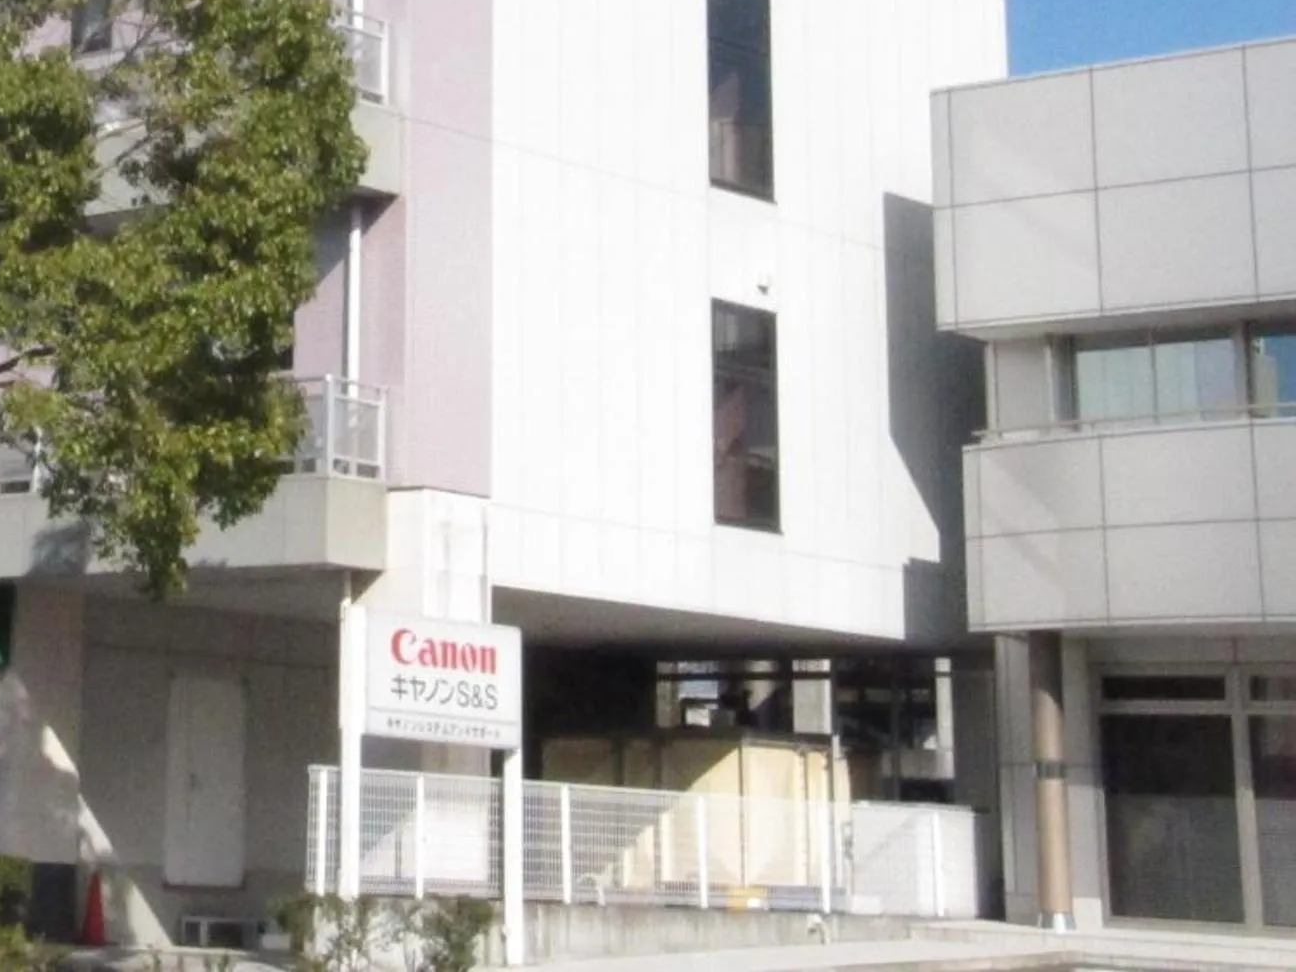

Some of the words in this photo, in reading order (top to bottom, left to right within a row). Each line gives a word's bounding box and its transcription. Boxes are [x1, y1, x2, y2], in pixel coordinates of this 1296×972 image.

[391, 628, 497, 675] Canon
[391, 674, 499, 710] キヤノンS&S
